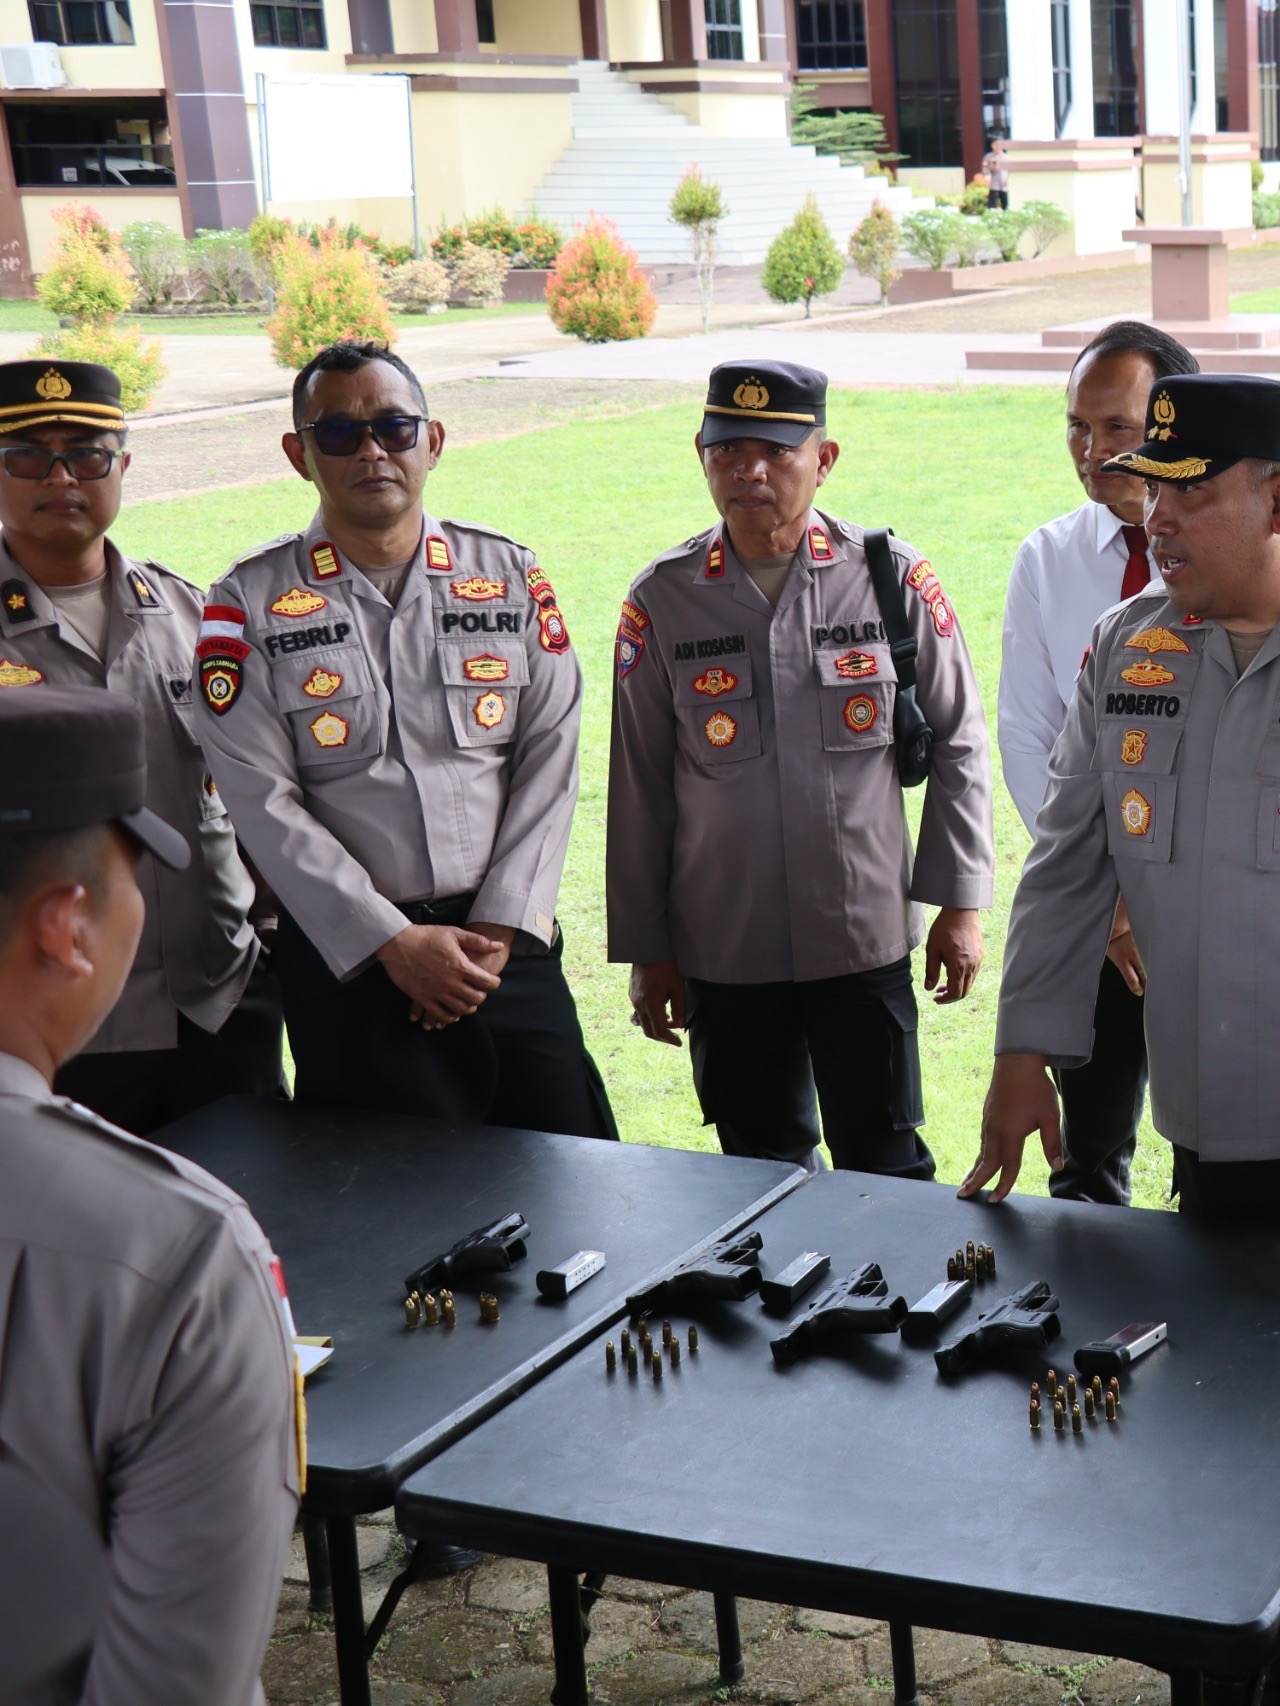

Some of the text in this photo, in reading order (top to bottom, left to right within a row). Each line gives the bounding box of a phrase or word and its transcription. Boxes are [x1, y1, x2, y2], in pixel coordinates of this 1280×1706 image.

[442, 612, 521, 633] POLRI
[815, 620, 885, 646] POLRI
[265, 622, 350, 658] FEBRI.P
[675, 635, 746, 661] ADI KOSASIH
[1105, 693, 1180, 717] ROBERTO
